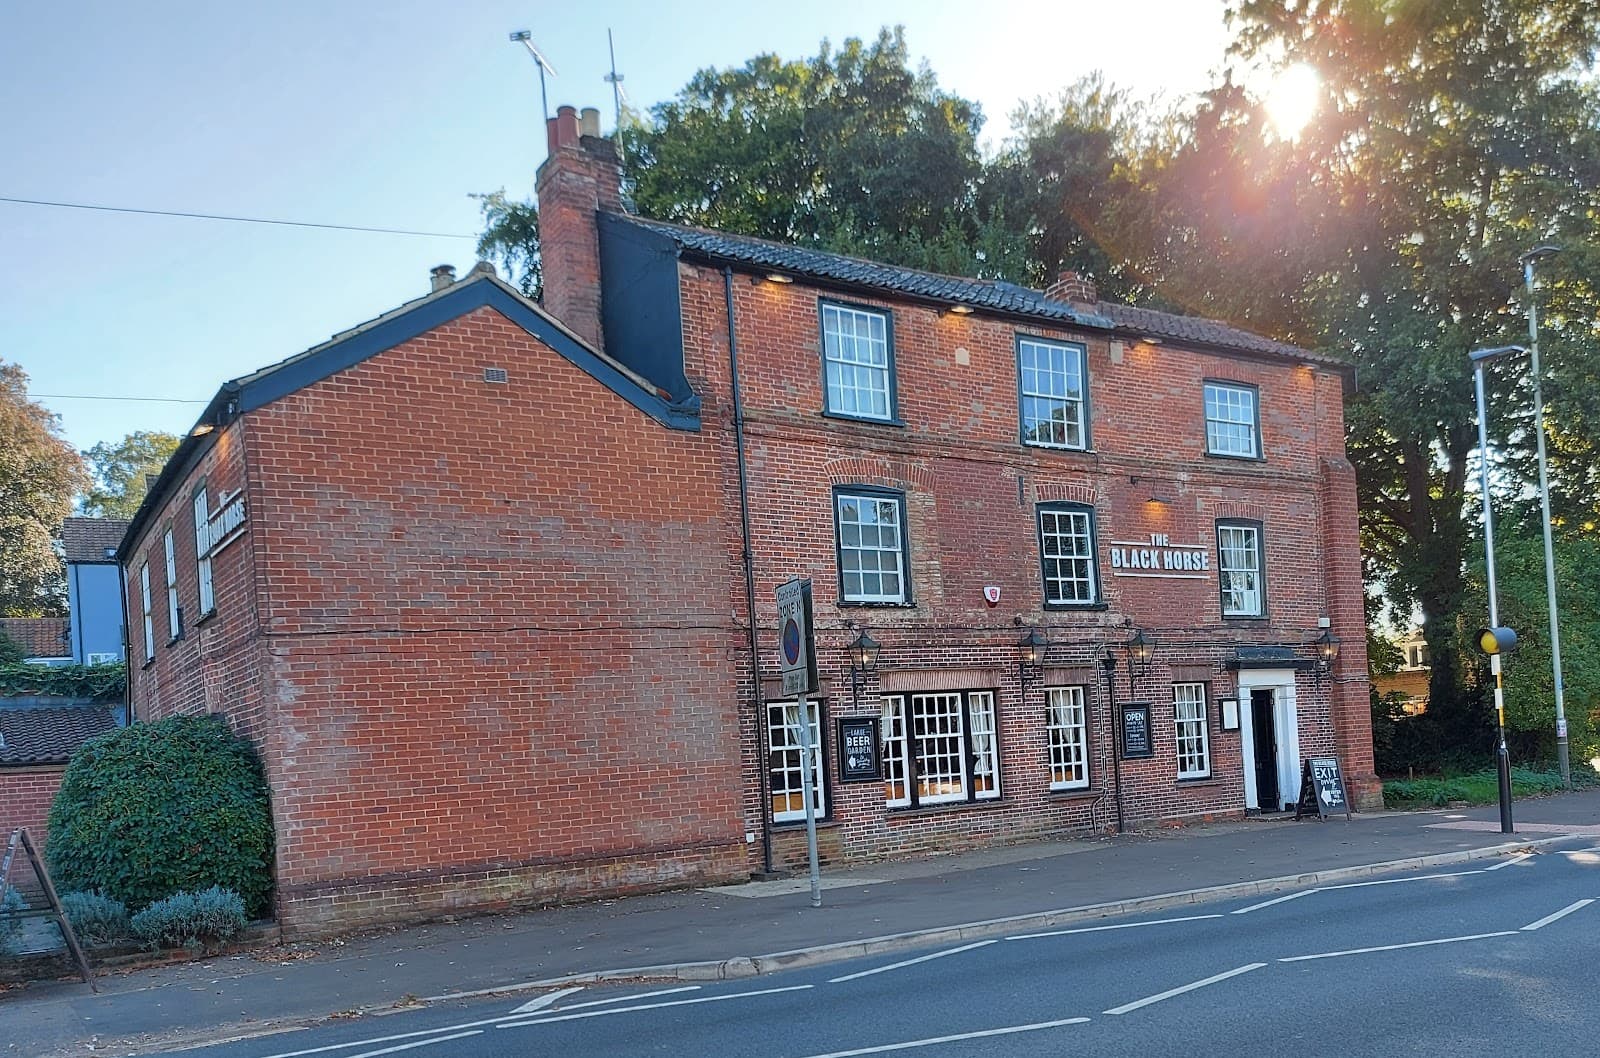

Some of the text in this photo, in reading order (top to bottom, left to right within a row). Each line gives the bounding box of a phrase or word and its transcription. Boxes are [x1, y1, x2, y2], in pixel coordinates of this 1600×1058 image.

[1150, 533, 1169, 547] THE
[1111, 548, 1210, 571] BLACK HORSE
[779, 602, 795, 618] ZONE
[1126, 712, 1144, 722] OPEN
[847, 736, 870, 747] BEER
[1314, 767, 1337, 779] EXIT
